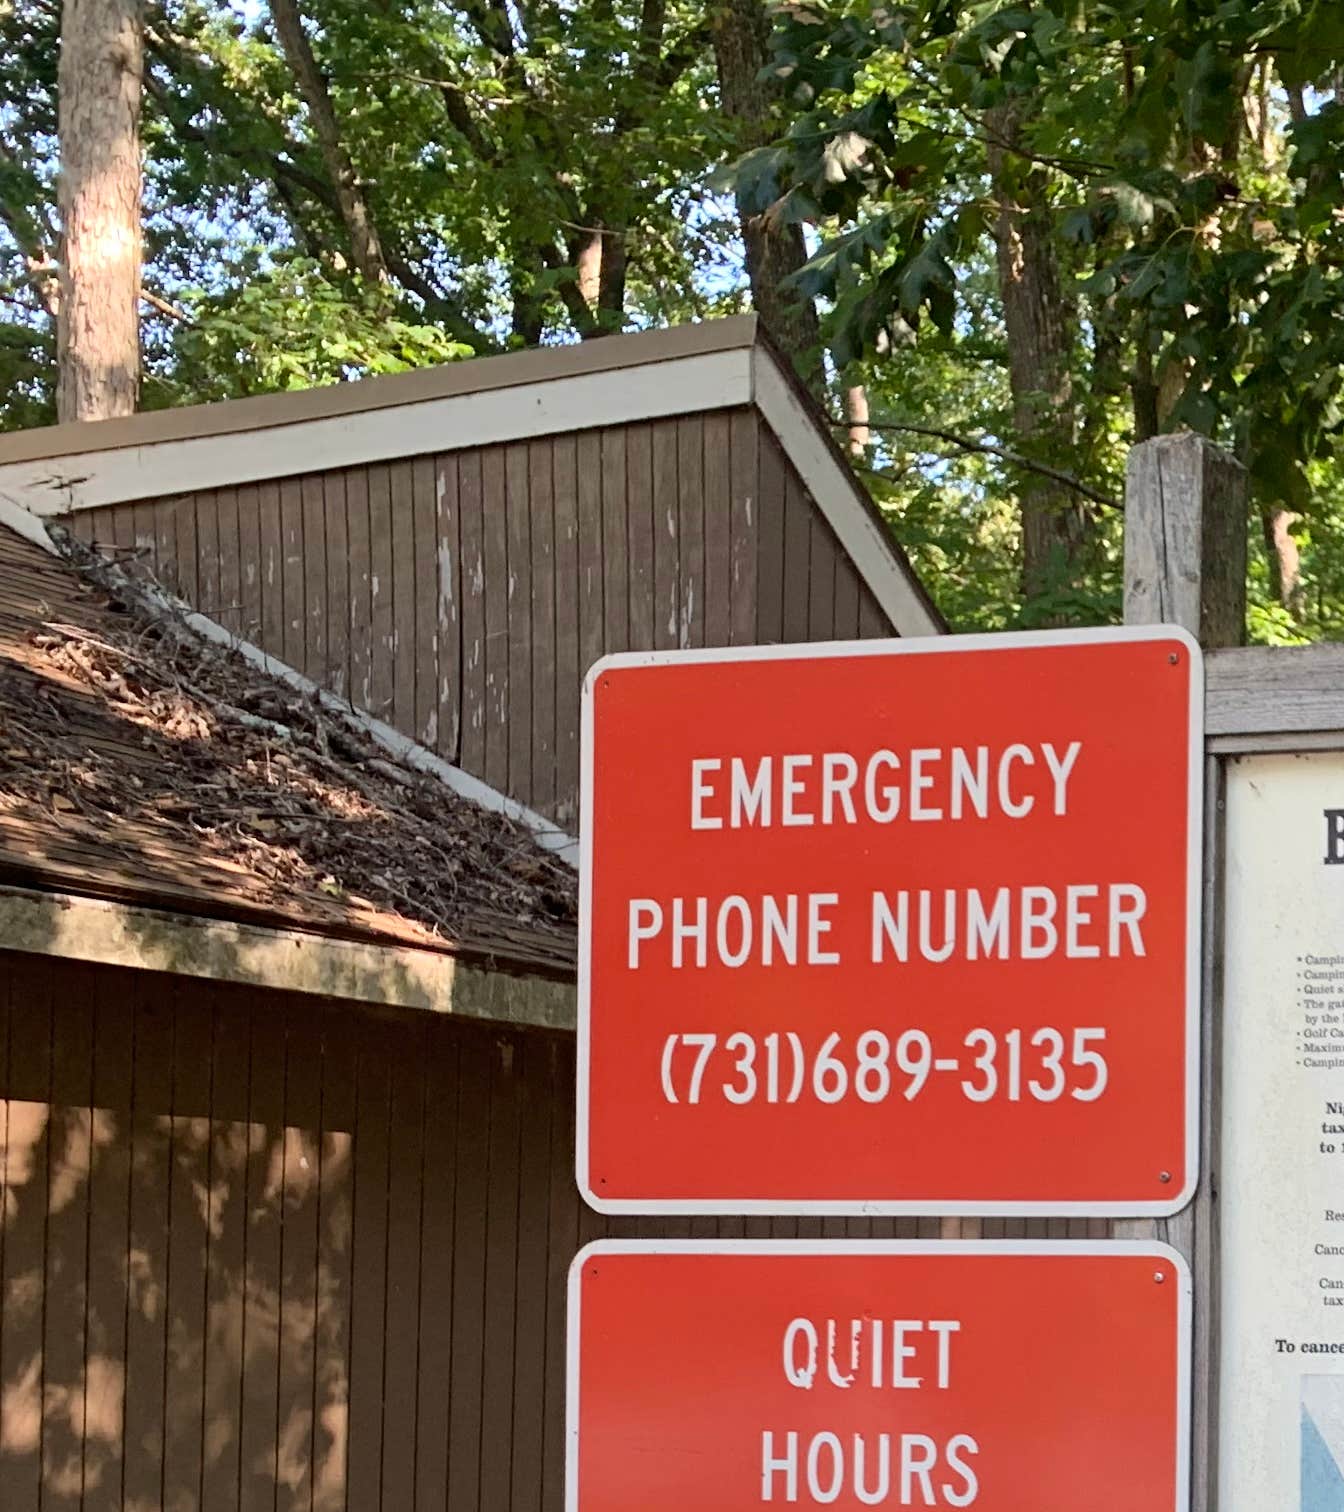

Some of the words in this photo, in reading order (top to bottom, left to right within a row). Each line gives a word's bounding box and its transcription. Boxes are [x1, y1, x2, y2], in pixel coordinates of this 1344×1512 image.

[691, 742, 1081, 830] EMERGENCY
[628, 892, 839, 969] PHONE
[871, 883, 1146, 964] NUMBER
[661, 1027, 1108, 1104] (731)689-3135
[783, 1317, 960, 1389] QUIET
[1274, 1339, 1295, 1352] To
[762, 1431, 979, 1507] HOURS
